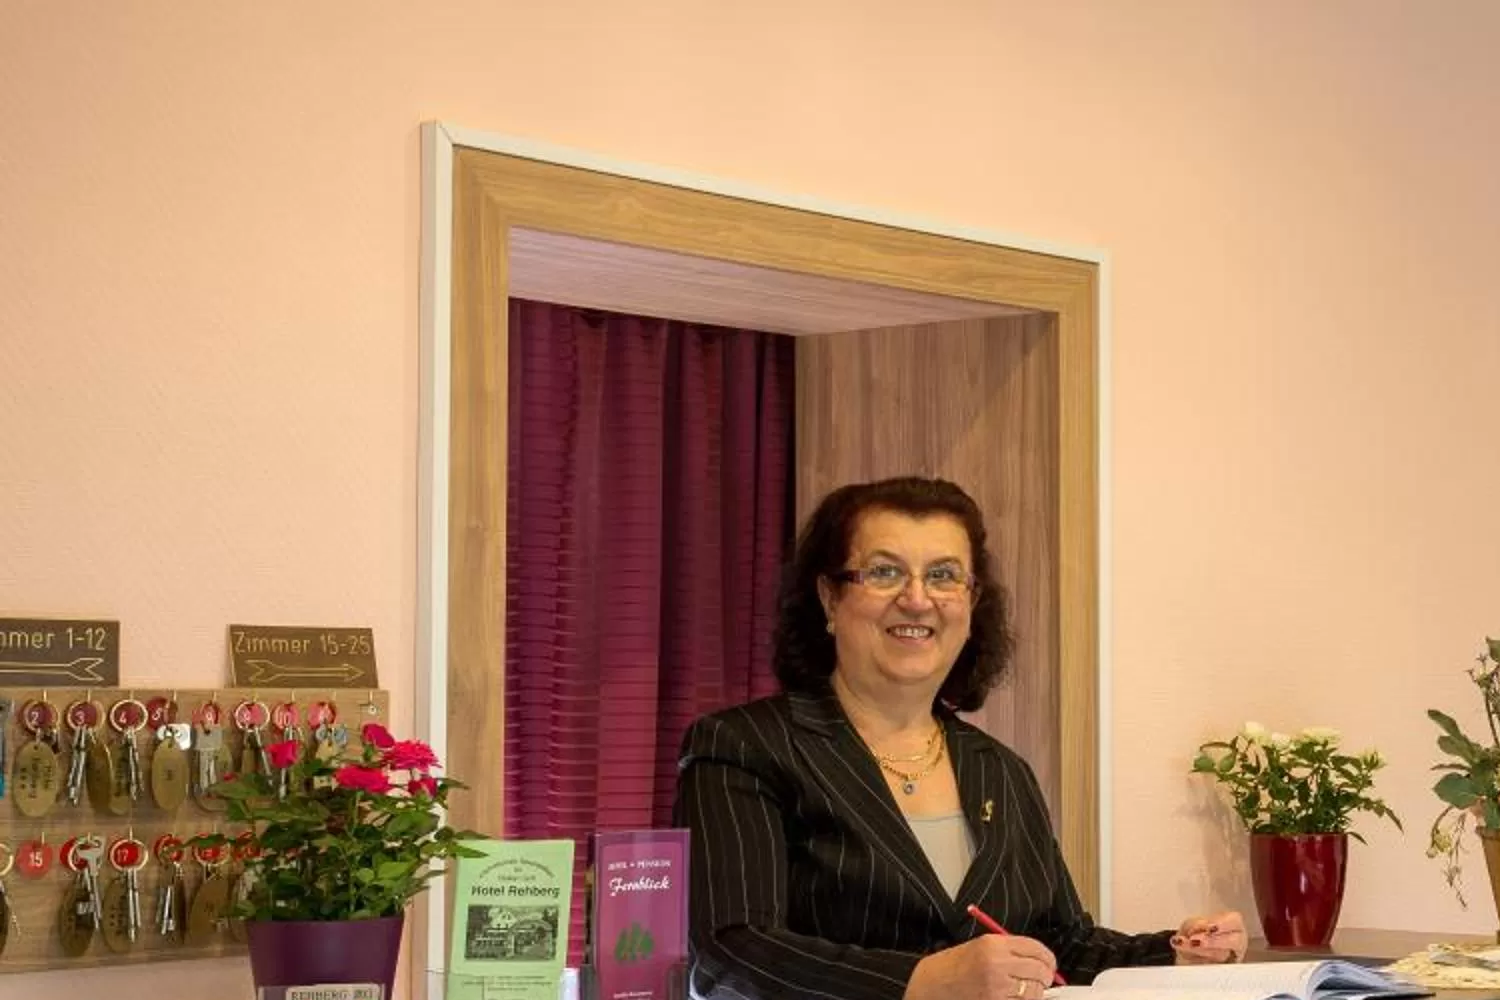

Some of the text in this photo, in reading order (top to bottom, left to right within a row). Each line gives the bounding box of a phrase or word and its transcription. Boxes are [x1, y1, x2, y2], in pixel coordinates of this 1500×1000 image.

[66, 627, 106, 651] 1-12
[232, 631, 371, 655] Zimmer 15-25
[31, 711, 39, 725] 2
[75, 711, 85, 724] 3
[30, 851, 43, 867] 15
[471, 885, 561, 898] Hotel Rehberg
